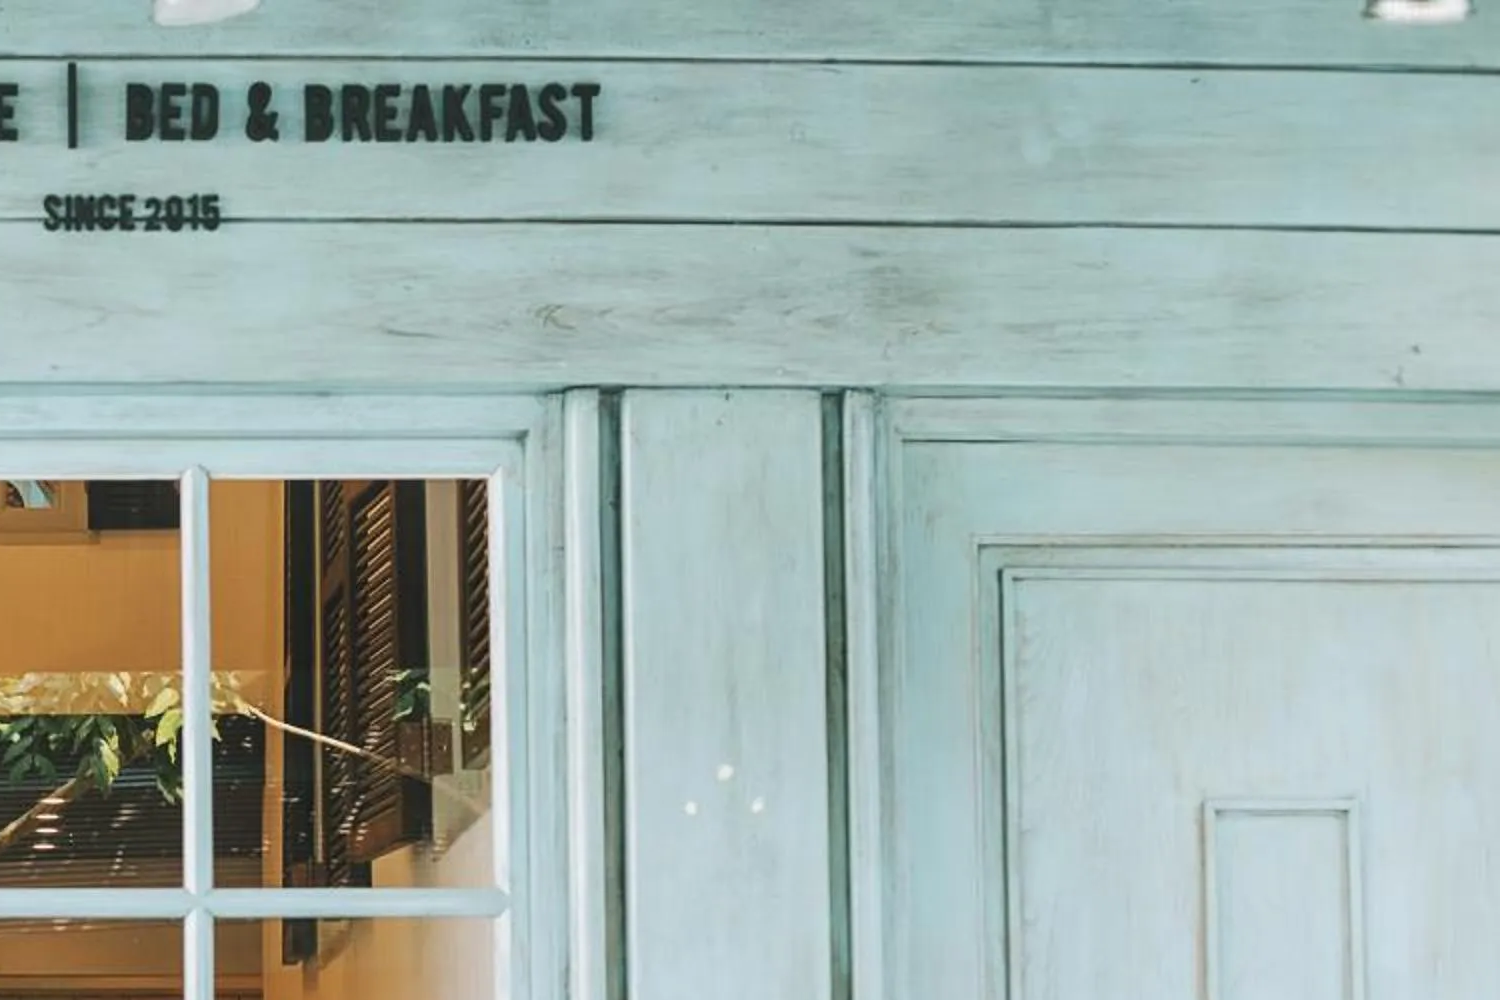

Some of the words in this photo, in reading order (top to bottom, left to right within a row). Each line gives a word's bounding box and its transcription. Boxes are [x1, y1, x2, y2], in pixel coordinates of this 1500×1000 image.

[125, 82, 220, 142] BED
[245, 81, 280, 142] &
[304, 83, 602, 142] BREAKFAST
[43, 194, 136, 232] SINCE
[144, 194, 221, 232] 2015
